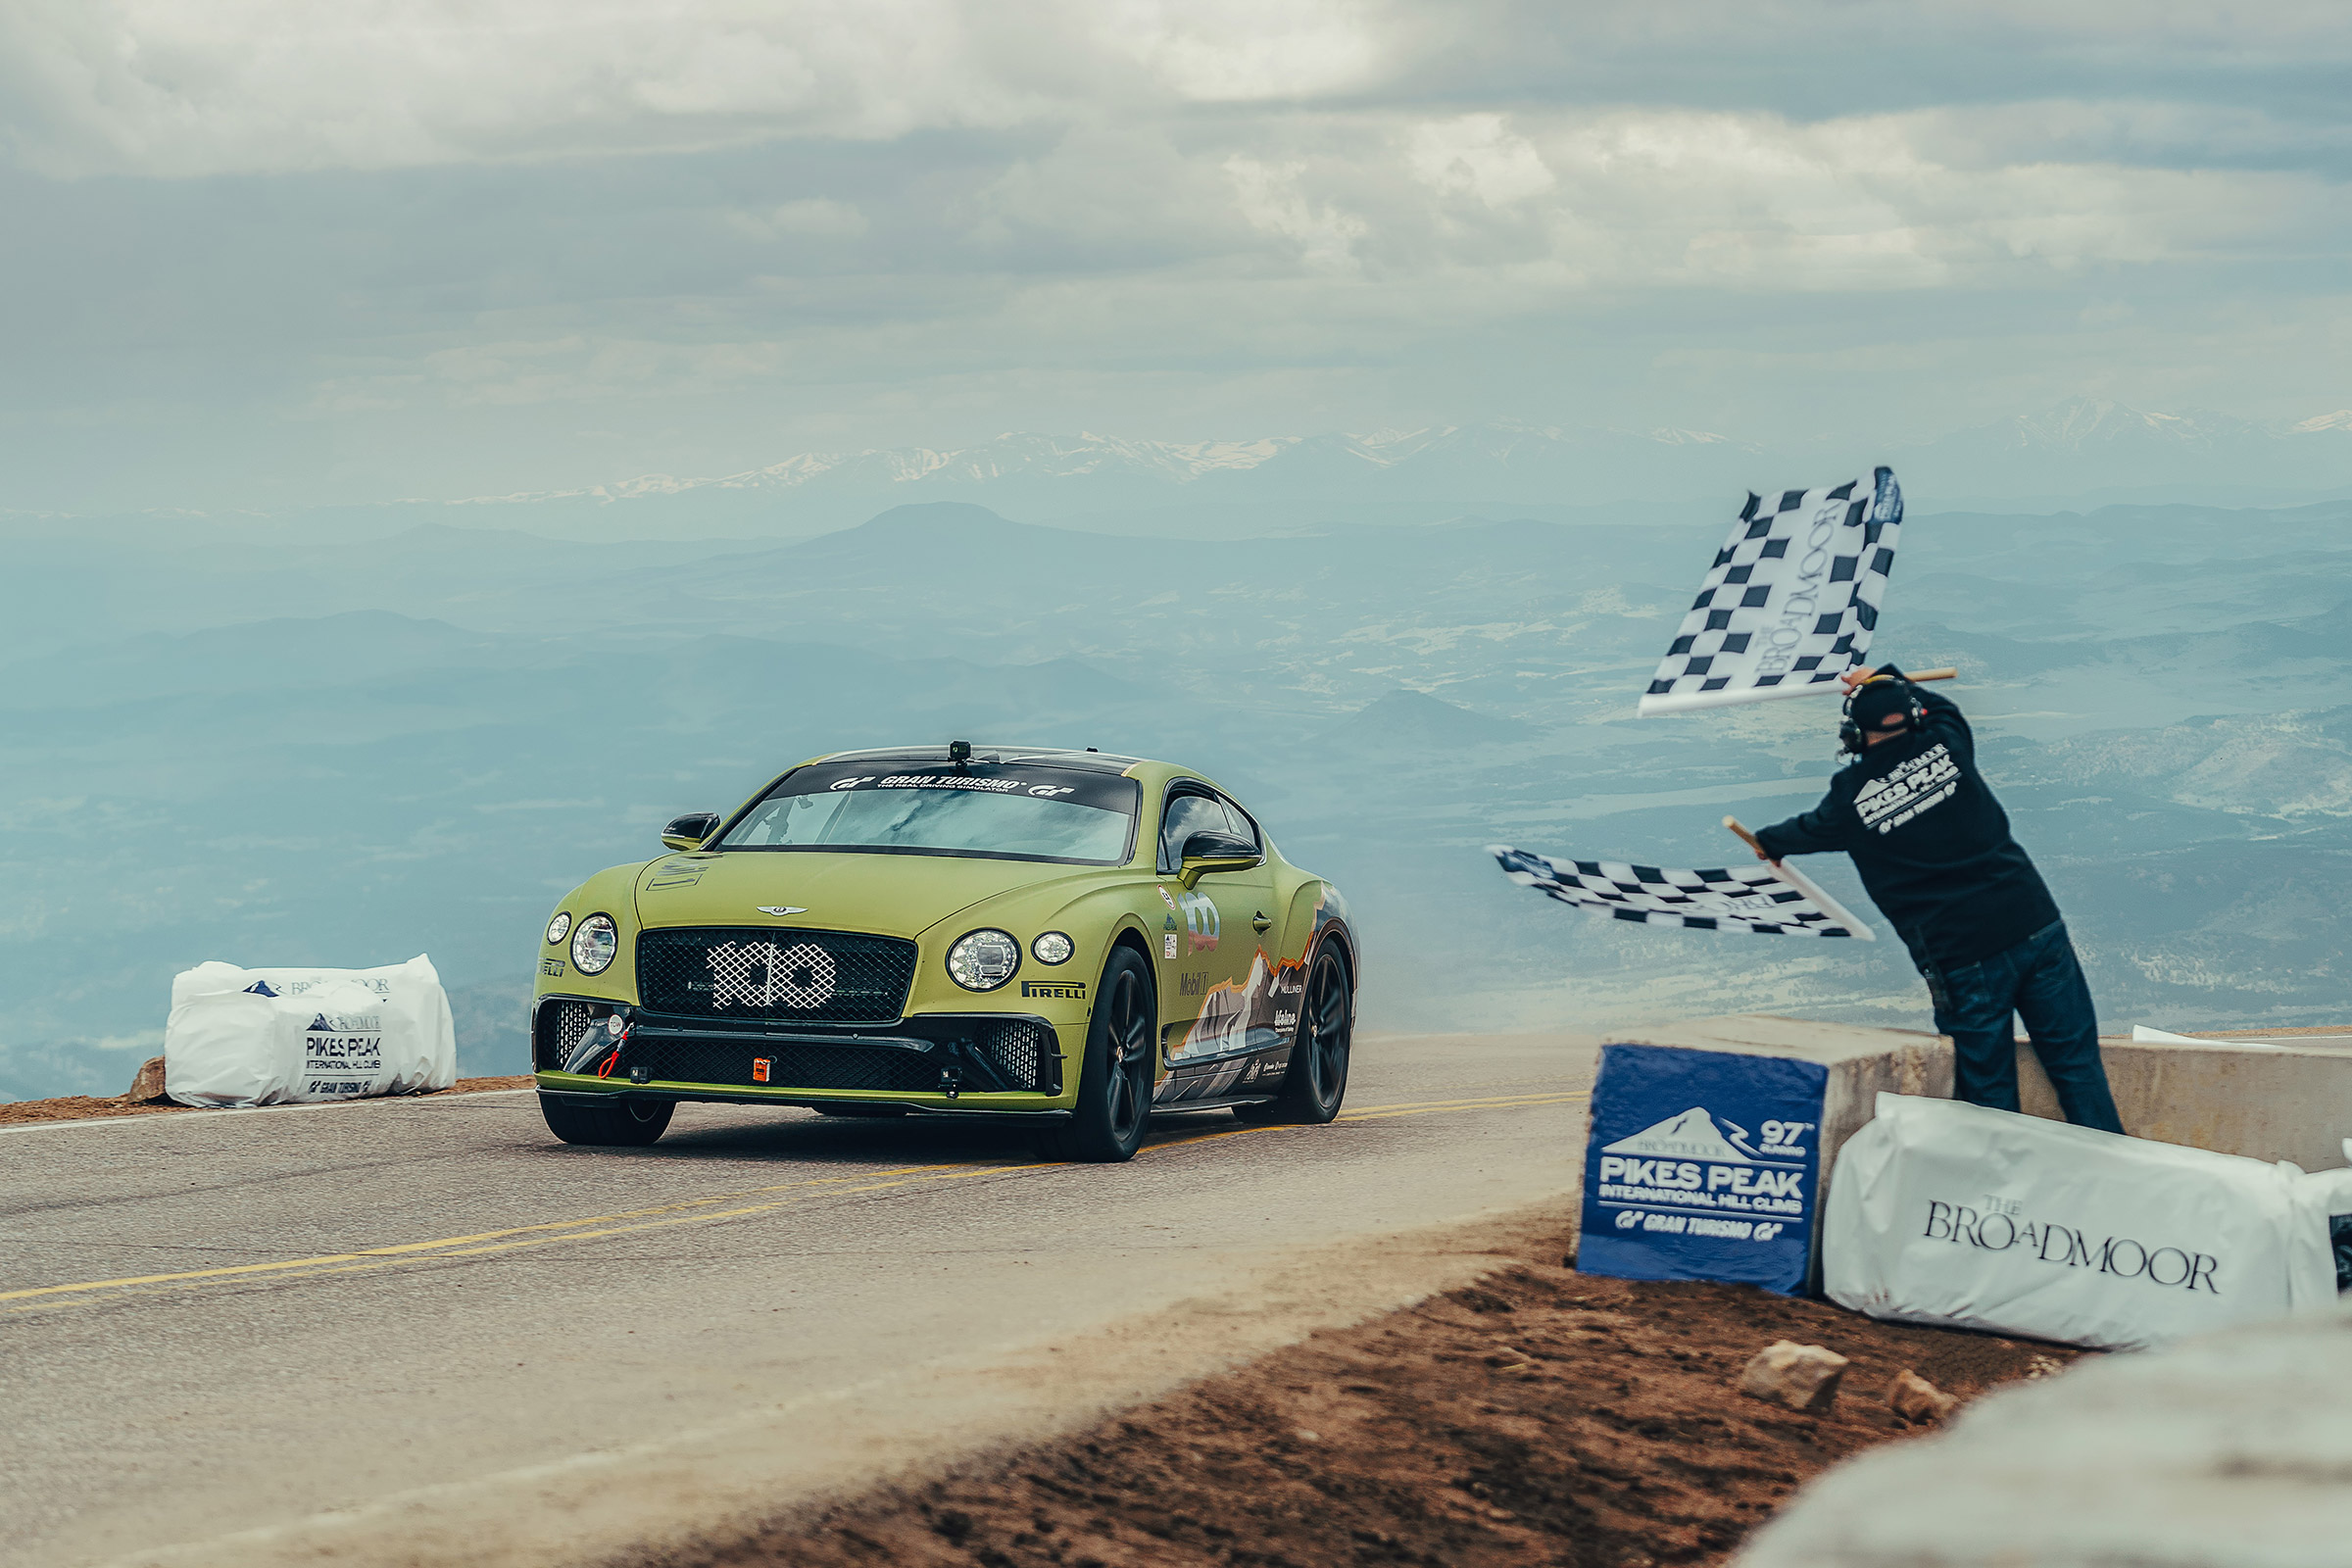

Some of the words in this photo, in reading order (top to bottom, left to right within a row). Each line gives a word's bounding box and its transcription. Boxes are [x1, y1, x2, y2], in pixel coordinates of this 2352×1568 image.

[1754, 501, 1842, 674] BROADMOOR
[880, 775, 936, 784] GRAN
[936, 776, 1020, 790] TURISMO
[959, 784, 1009, 793] SIMULATOR
[1856, 782, 1909, 818] PIKES
[1906, 754, 1954, 793] PEAK
[706, 941, 837, 1010] 100
[1179, 972, 1201, 997] Mobil
[1021, 980, 1086, 1000] PIRELLI
[306, 1037, 346, 1057] PIKES
[348, 1037, 381, 1057] PEAK
[1599, 1155, 1703, 1192] PIKES
[1707, 1164, 1804, 1200] PEAK
[1598, 1183, 1717, 1207] INTERNATIONAL
[1718, 1193, 1752, 1210] HILL
[1751, 1196, 1803, 1215] CLIMB
[1984, 1193, 2024, 1216] THE
[1642, 1213, 1688, 1235] GRAN
[1922, 1199, 2222, 1296] BROADMOOR
